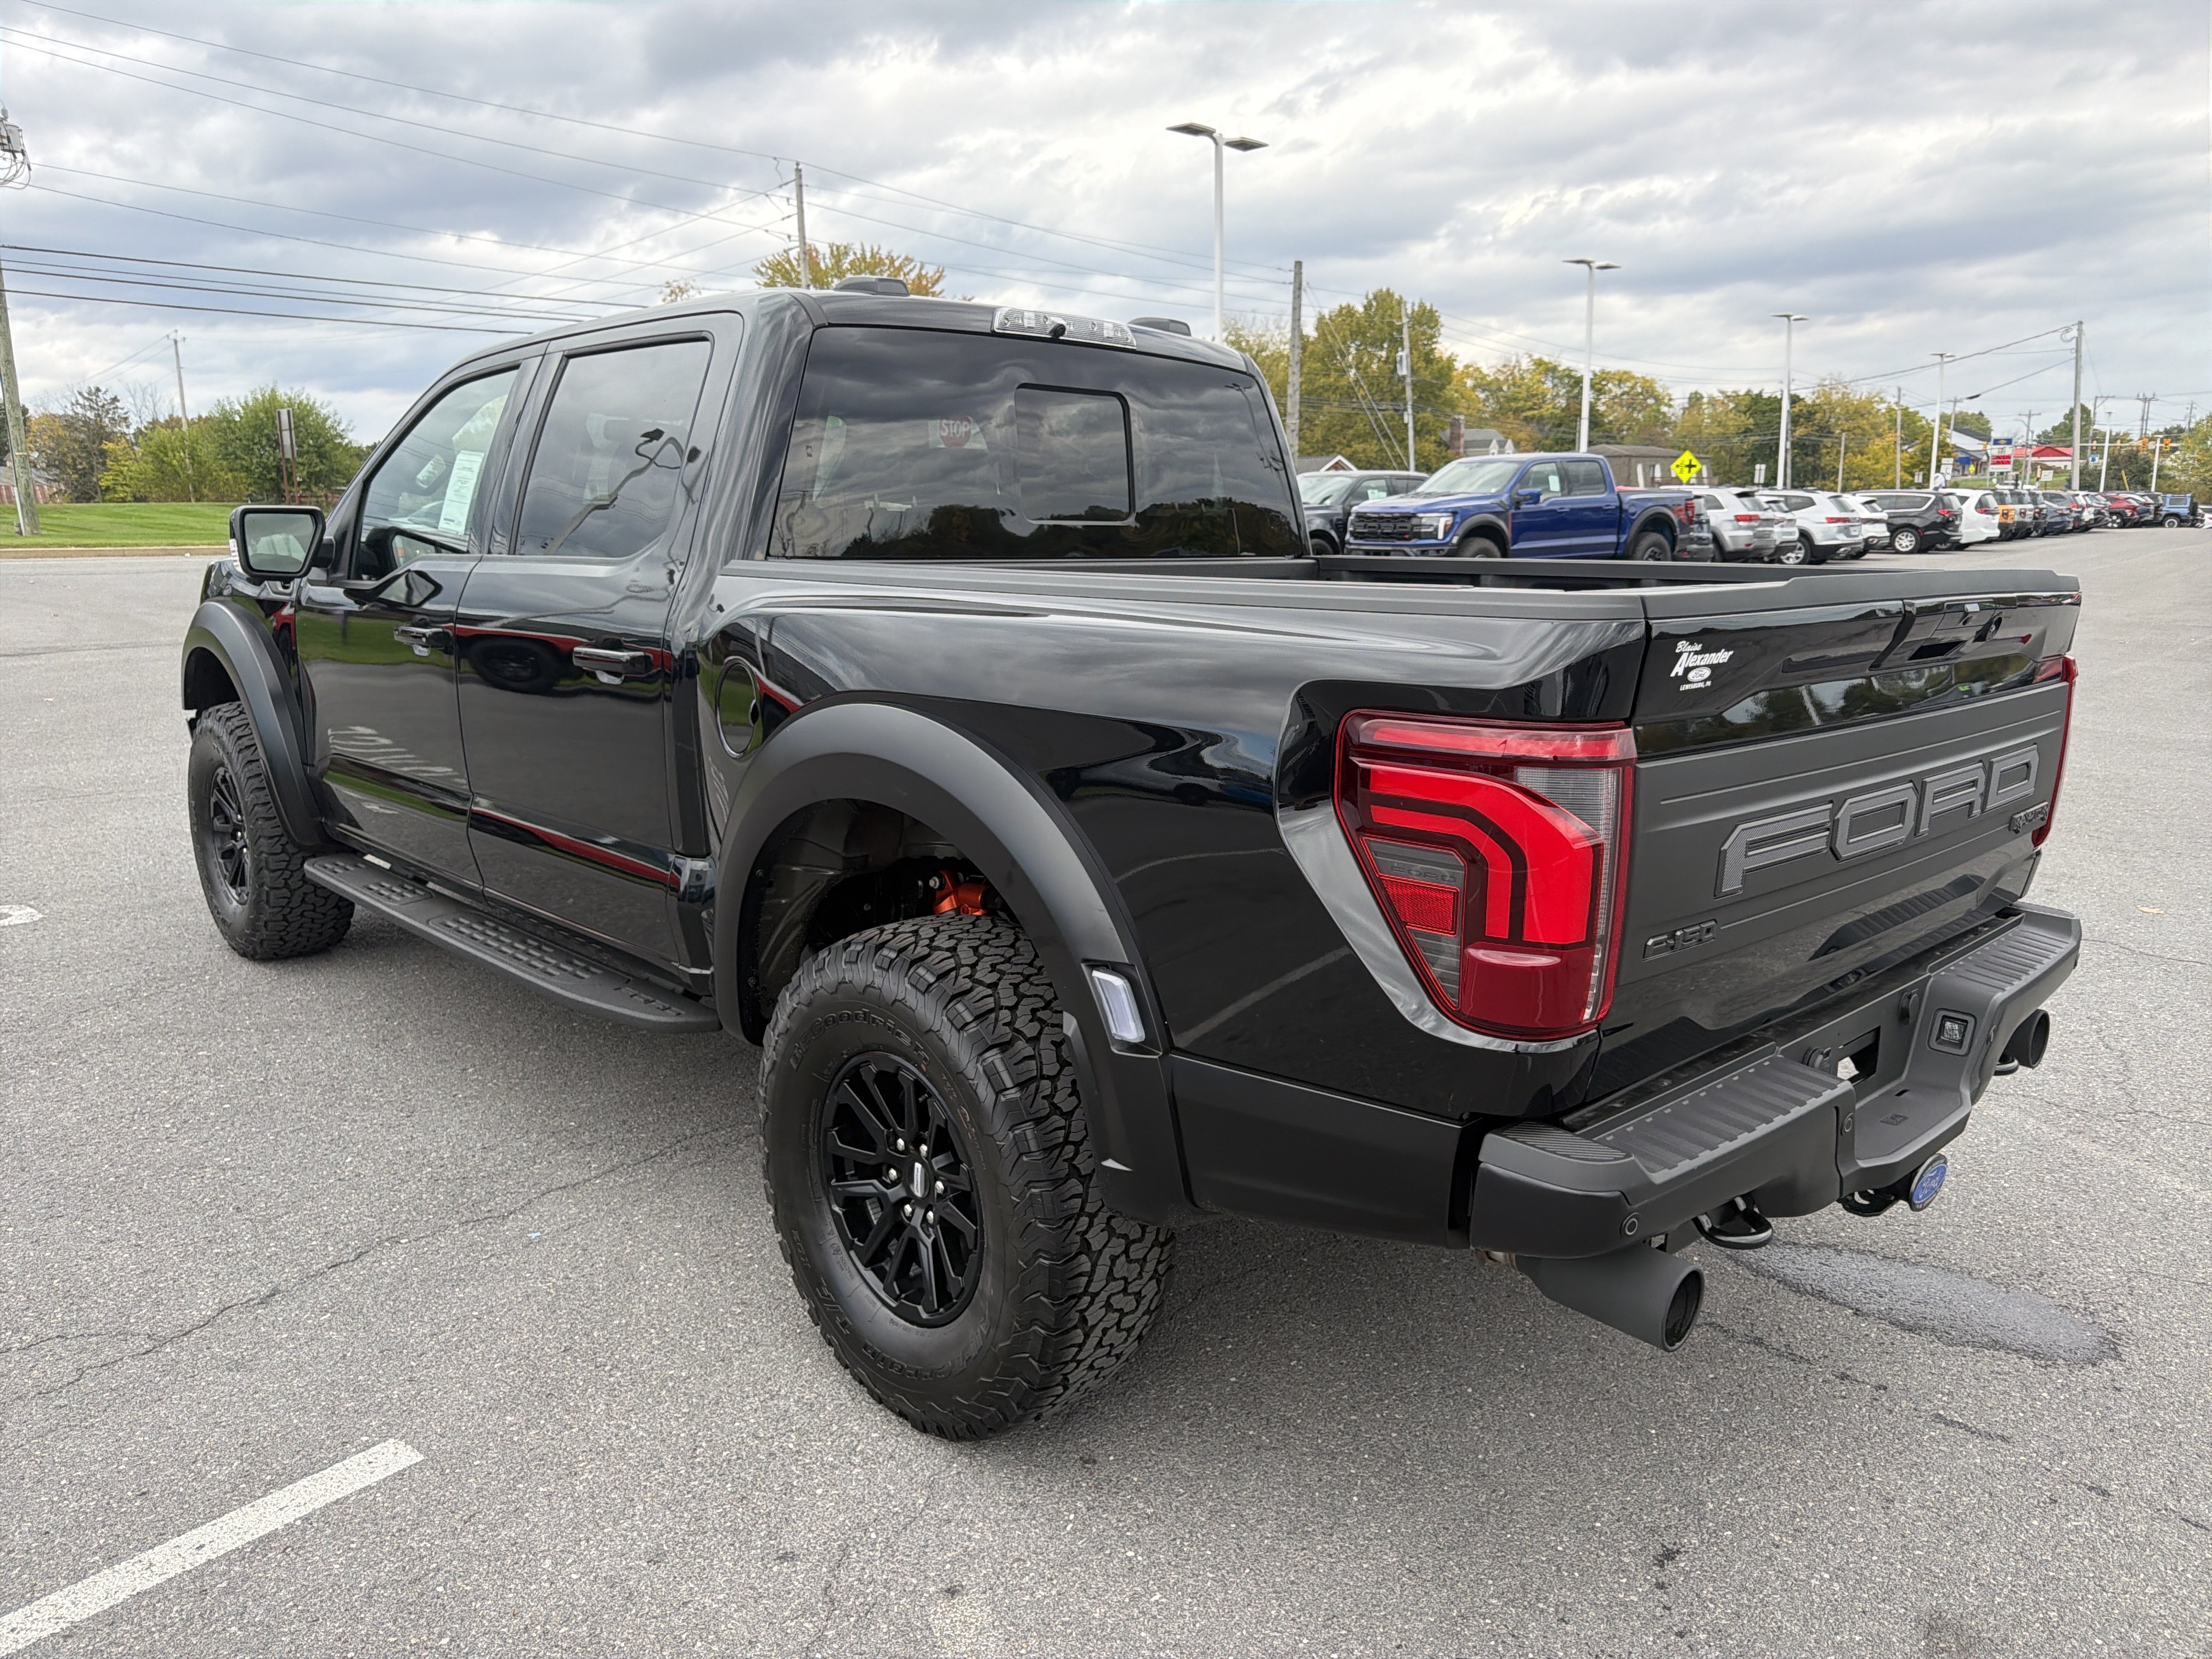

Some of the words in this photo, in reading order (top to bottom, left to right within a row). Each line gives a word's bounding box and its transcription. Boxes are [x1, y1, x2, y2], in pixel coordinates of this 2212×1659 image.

[940, 420, 970, 438] STOP
[1675, 640, 1703, 652] Blaise
[1670, 648, 1734, 676] Alexander
[1713, 743, 2040, 900] FORD
[1390, 866, 1457, 882] FORD
[1643, 918, 1718, 961] F-150
[1918, 1169, 1943, 1199] Ford
